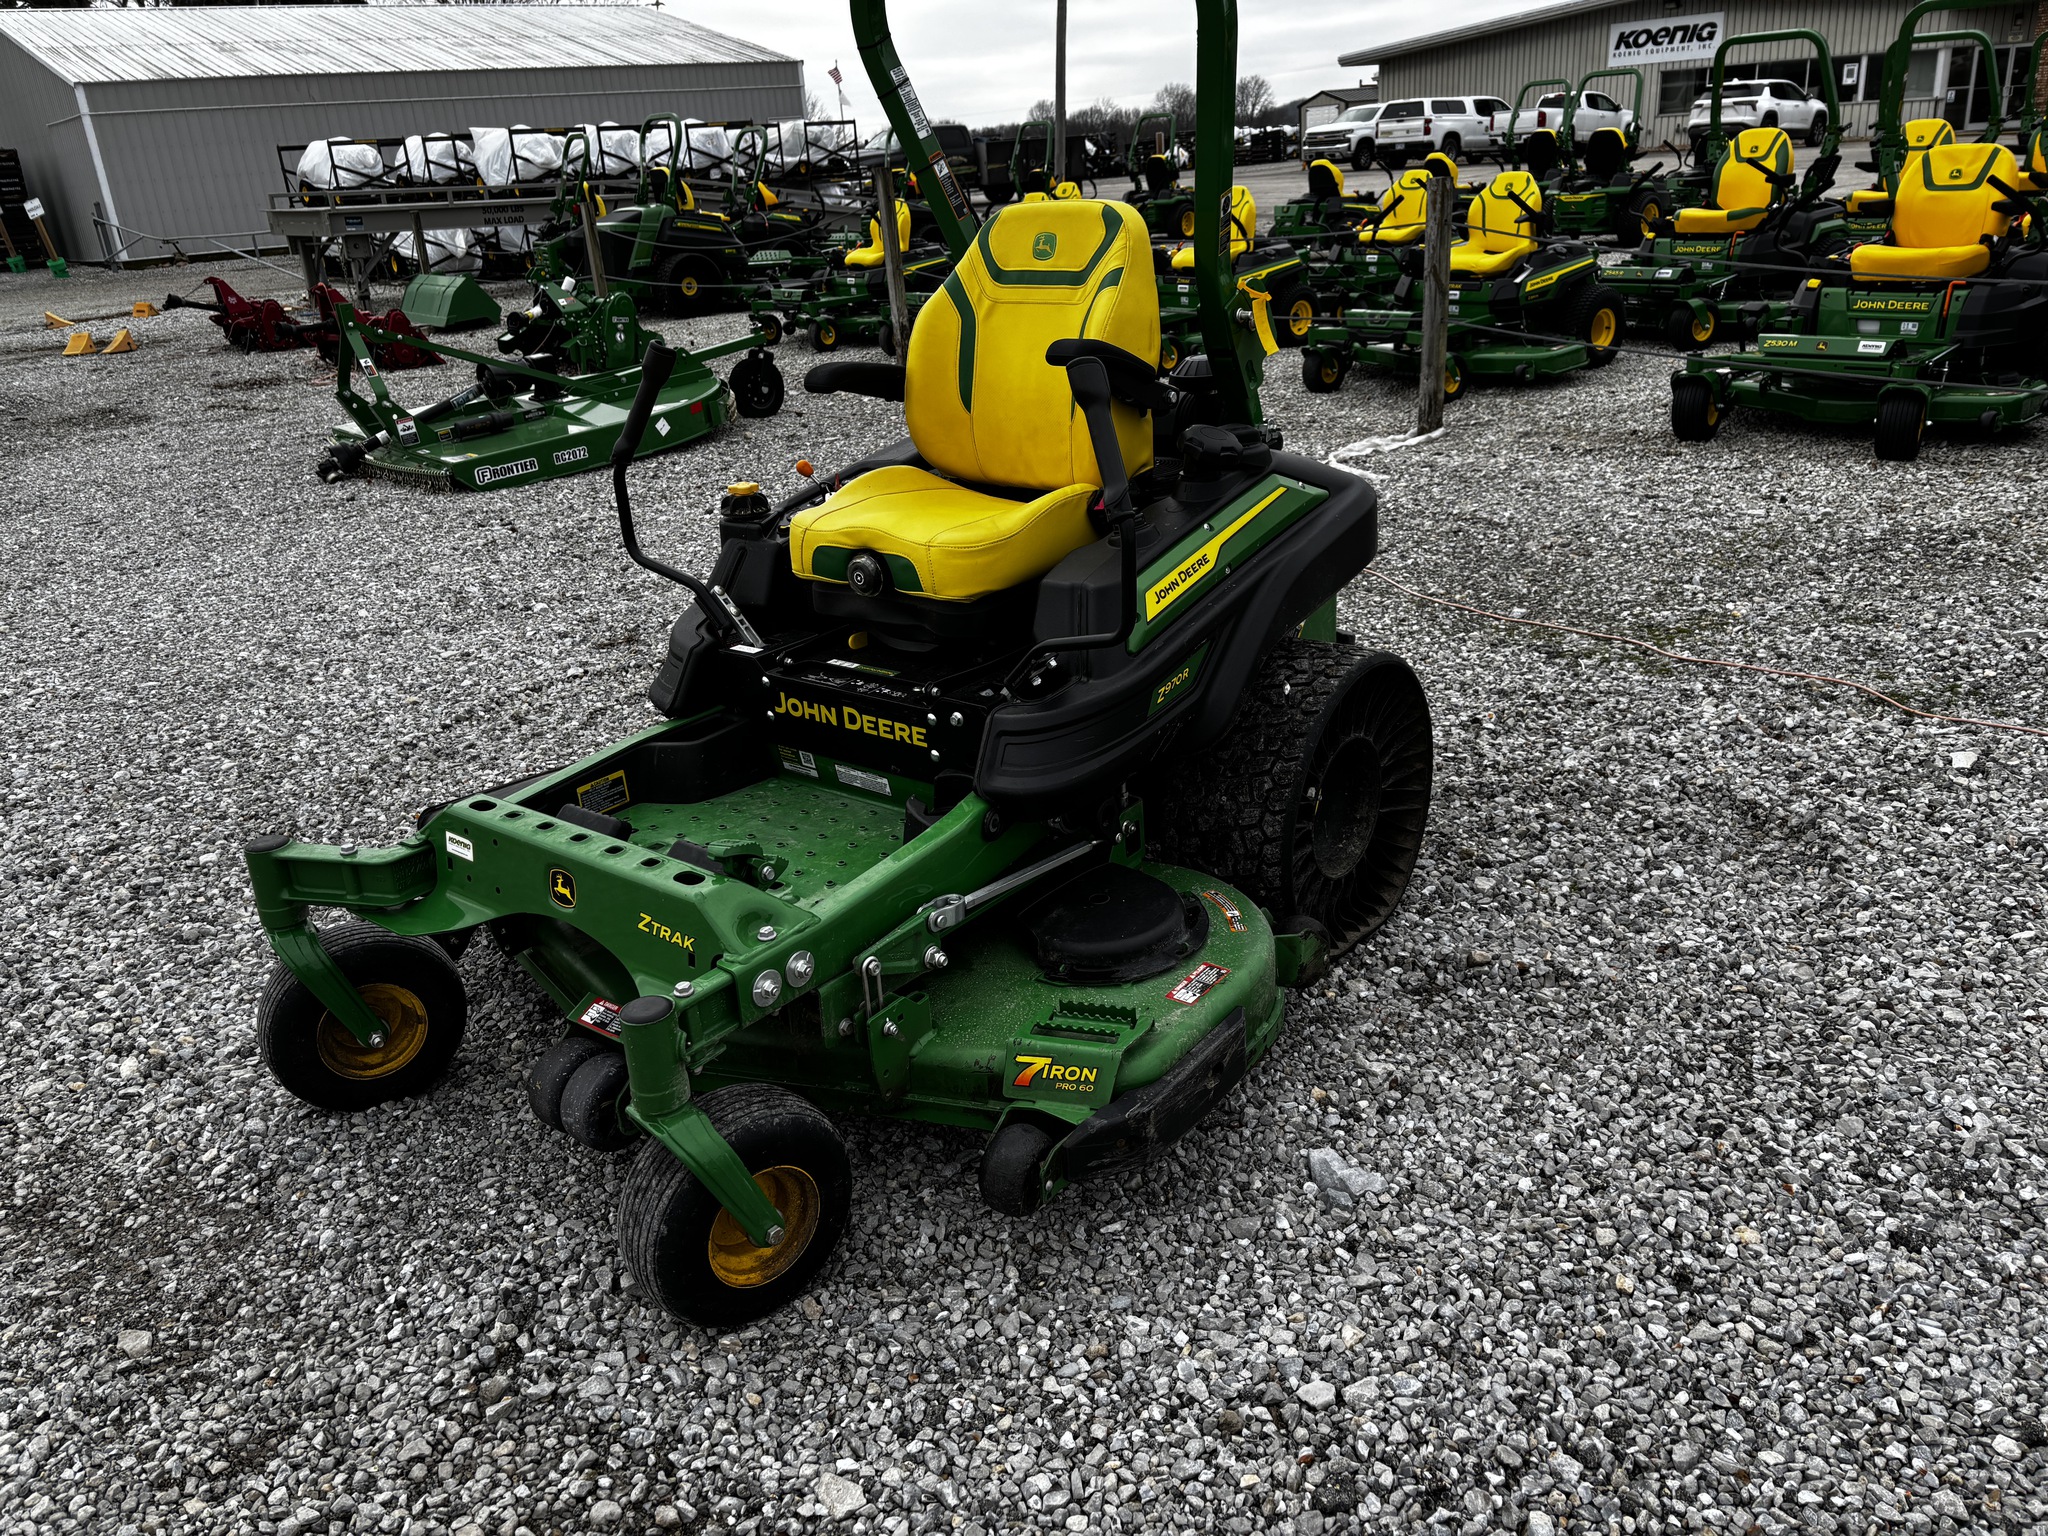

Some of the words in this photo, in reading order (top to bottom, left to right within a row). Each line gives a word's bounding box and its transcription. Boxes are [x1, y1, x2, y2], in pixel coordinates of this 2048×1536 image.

[1613, 48, 1641, 58] KOENIG
[484, 216, 502, 225] MAX
[503, 215, 524, 224] LOAD
[1673, 245, 1695, 254] JOHN
[1853, 299, 1886, 309] JOHN
[1887, 299, 1930, 310] DEERE
[475, 459, 538, 483] FRONTIER
[554, 446, 588, 465] RC2072
[1154, 578, 1180, 605] JOHN
[1177, 553, 1210, 584] DEERE
[775, 691, 838, 727] JOHN
[842, 705, 928, 748] DEERE
[637, 911, 697, 953] ZTRAK
[1055, 1082, 1077, 1091] PRO
[1078, 1084, 1094, 1092] 60
